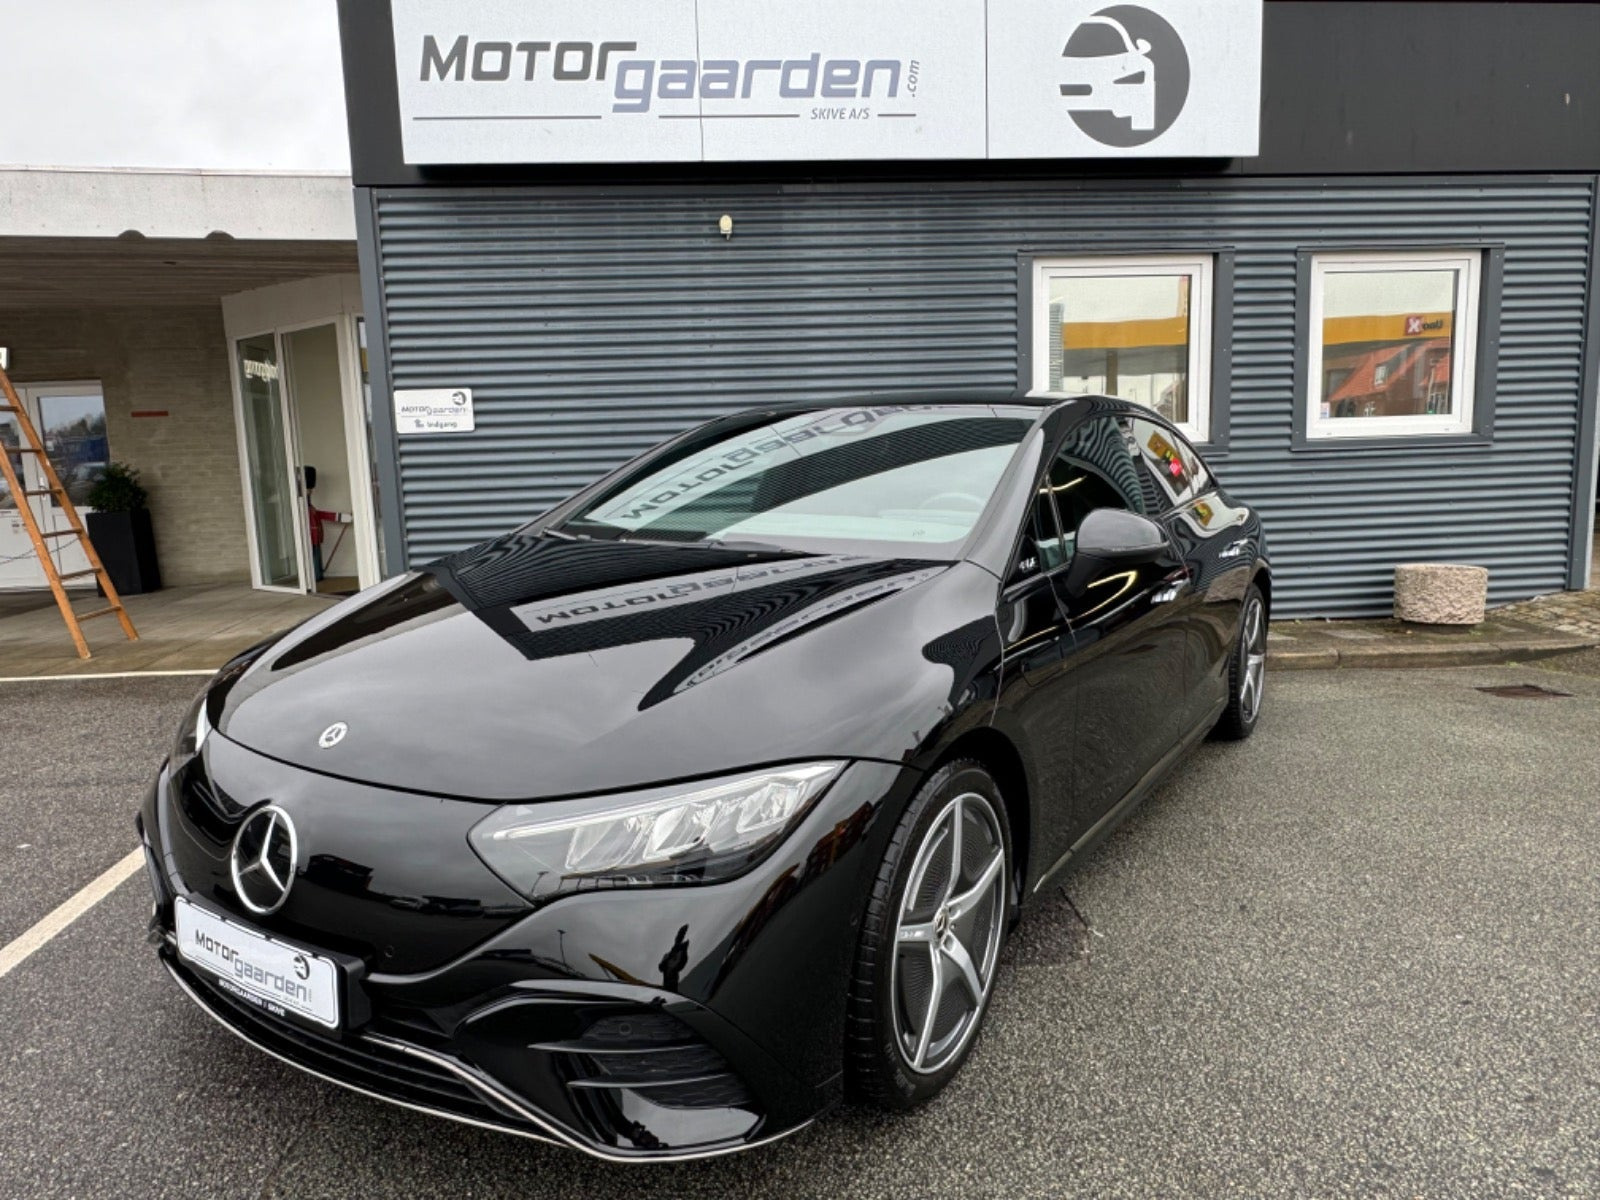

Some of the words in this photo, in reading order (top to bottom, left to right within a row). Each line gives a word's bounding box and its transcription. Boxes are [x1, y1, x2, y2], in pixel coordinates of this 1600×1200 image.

[907, 60, 920, 97] .com
[811, 107, 846, 120] SKIVE
[849, 107, 870, 120] A/S
